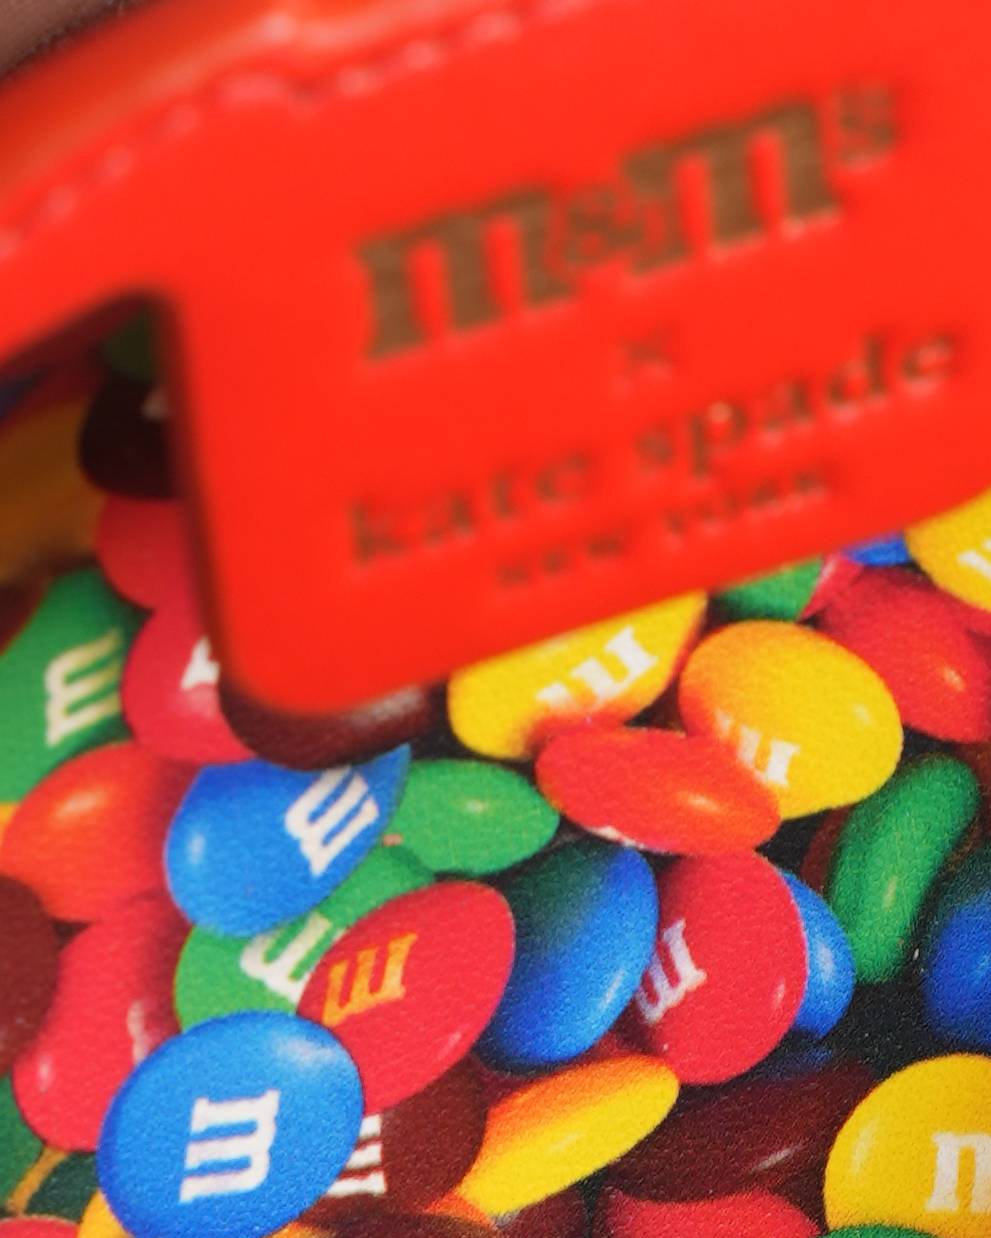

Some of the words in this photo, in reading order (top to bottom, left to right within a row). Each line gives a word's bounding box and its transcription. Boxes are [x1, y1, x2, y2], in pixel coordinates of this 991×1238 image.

[44, 630, 123, 748] m
[284, 766, 378, 876] m
[322, 932, 416, 1027] m
[179, 1089, 280, 1204] m
